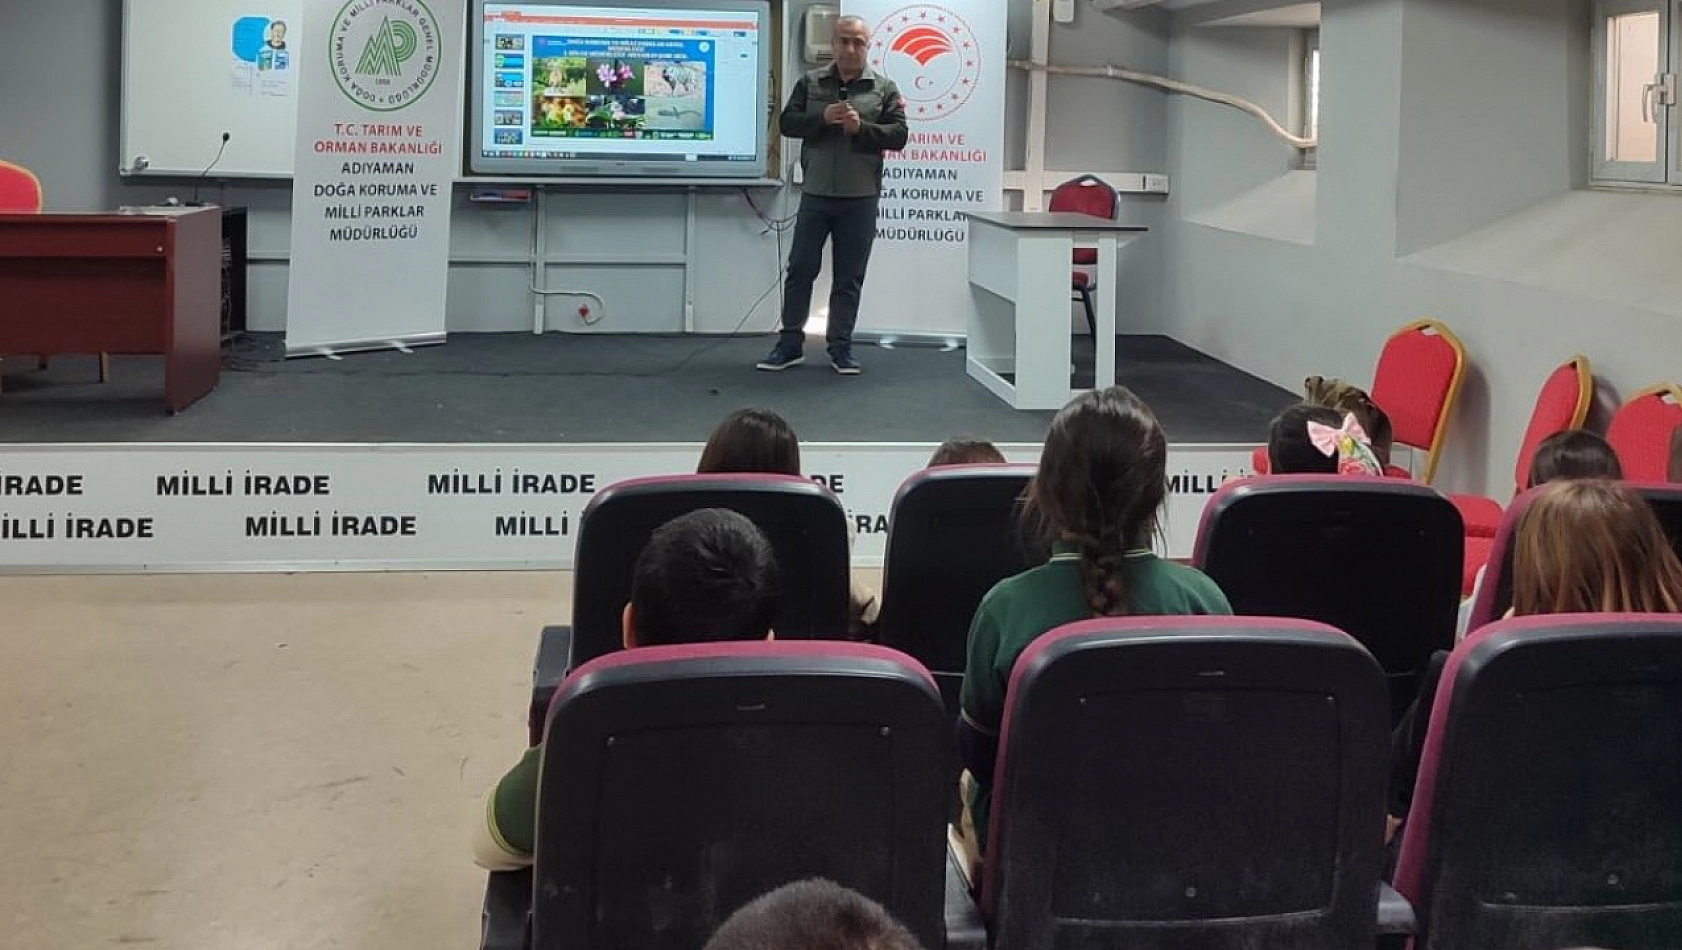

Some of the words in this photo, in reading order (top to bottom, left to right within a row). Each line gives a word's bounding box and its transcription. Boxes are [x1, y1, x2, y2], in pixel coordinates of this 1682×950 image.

[334, 123, 358, 136] T.C.
[363, 124, 402, 137] TARIM
[407, 125, 423, 137] VE
[908, 132, 943, 145] ARIM
[947, 133, 965, 146] VE
[314, 140, 367, 154] ORMAN
[371, 141, 442, 154] BAKANLIĞI
[912, 149, 987, 162] BAKANLIĞI
[342, 161, 414, 174] ADIYAMAN
[883, 168, 958, 180] ADIYAMAN
[314, 182, 356, 197] DOĞA
[359, 184, 418, 197] KORUMA
[420, 184, 438, 196] VE
[902, 188, 963, 202] KORUMA
[966, 190, 984, 203] VE
[325, 204, 361, 219] MİLLİ
[364, 205, 424, 218] PARKLAR
[878, 206, 905, 220] İLLİ
[330, 225, 418, 241] MÜDÜRLÜĞÜ
[0, 470, 83, 495] RADE
[156, 470, 232, 496] MİLLİ
[244, 470, 330, 495] İRADE
[428, 468, 501, 493] MİLLİ
[512, 468, 595, 493] İRADE
[2, 512, 55, 538] İLLİ
[65, 512, 153, 538] İRADE
[246, 510, 321, 537] MİLLİ
[332, 510, 417, 536] İRADE
[495, 510, 568, 536] MİLLİ
